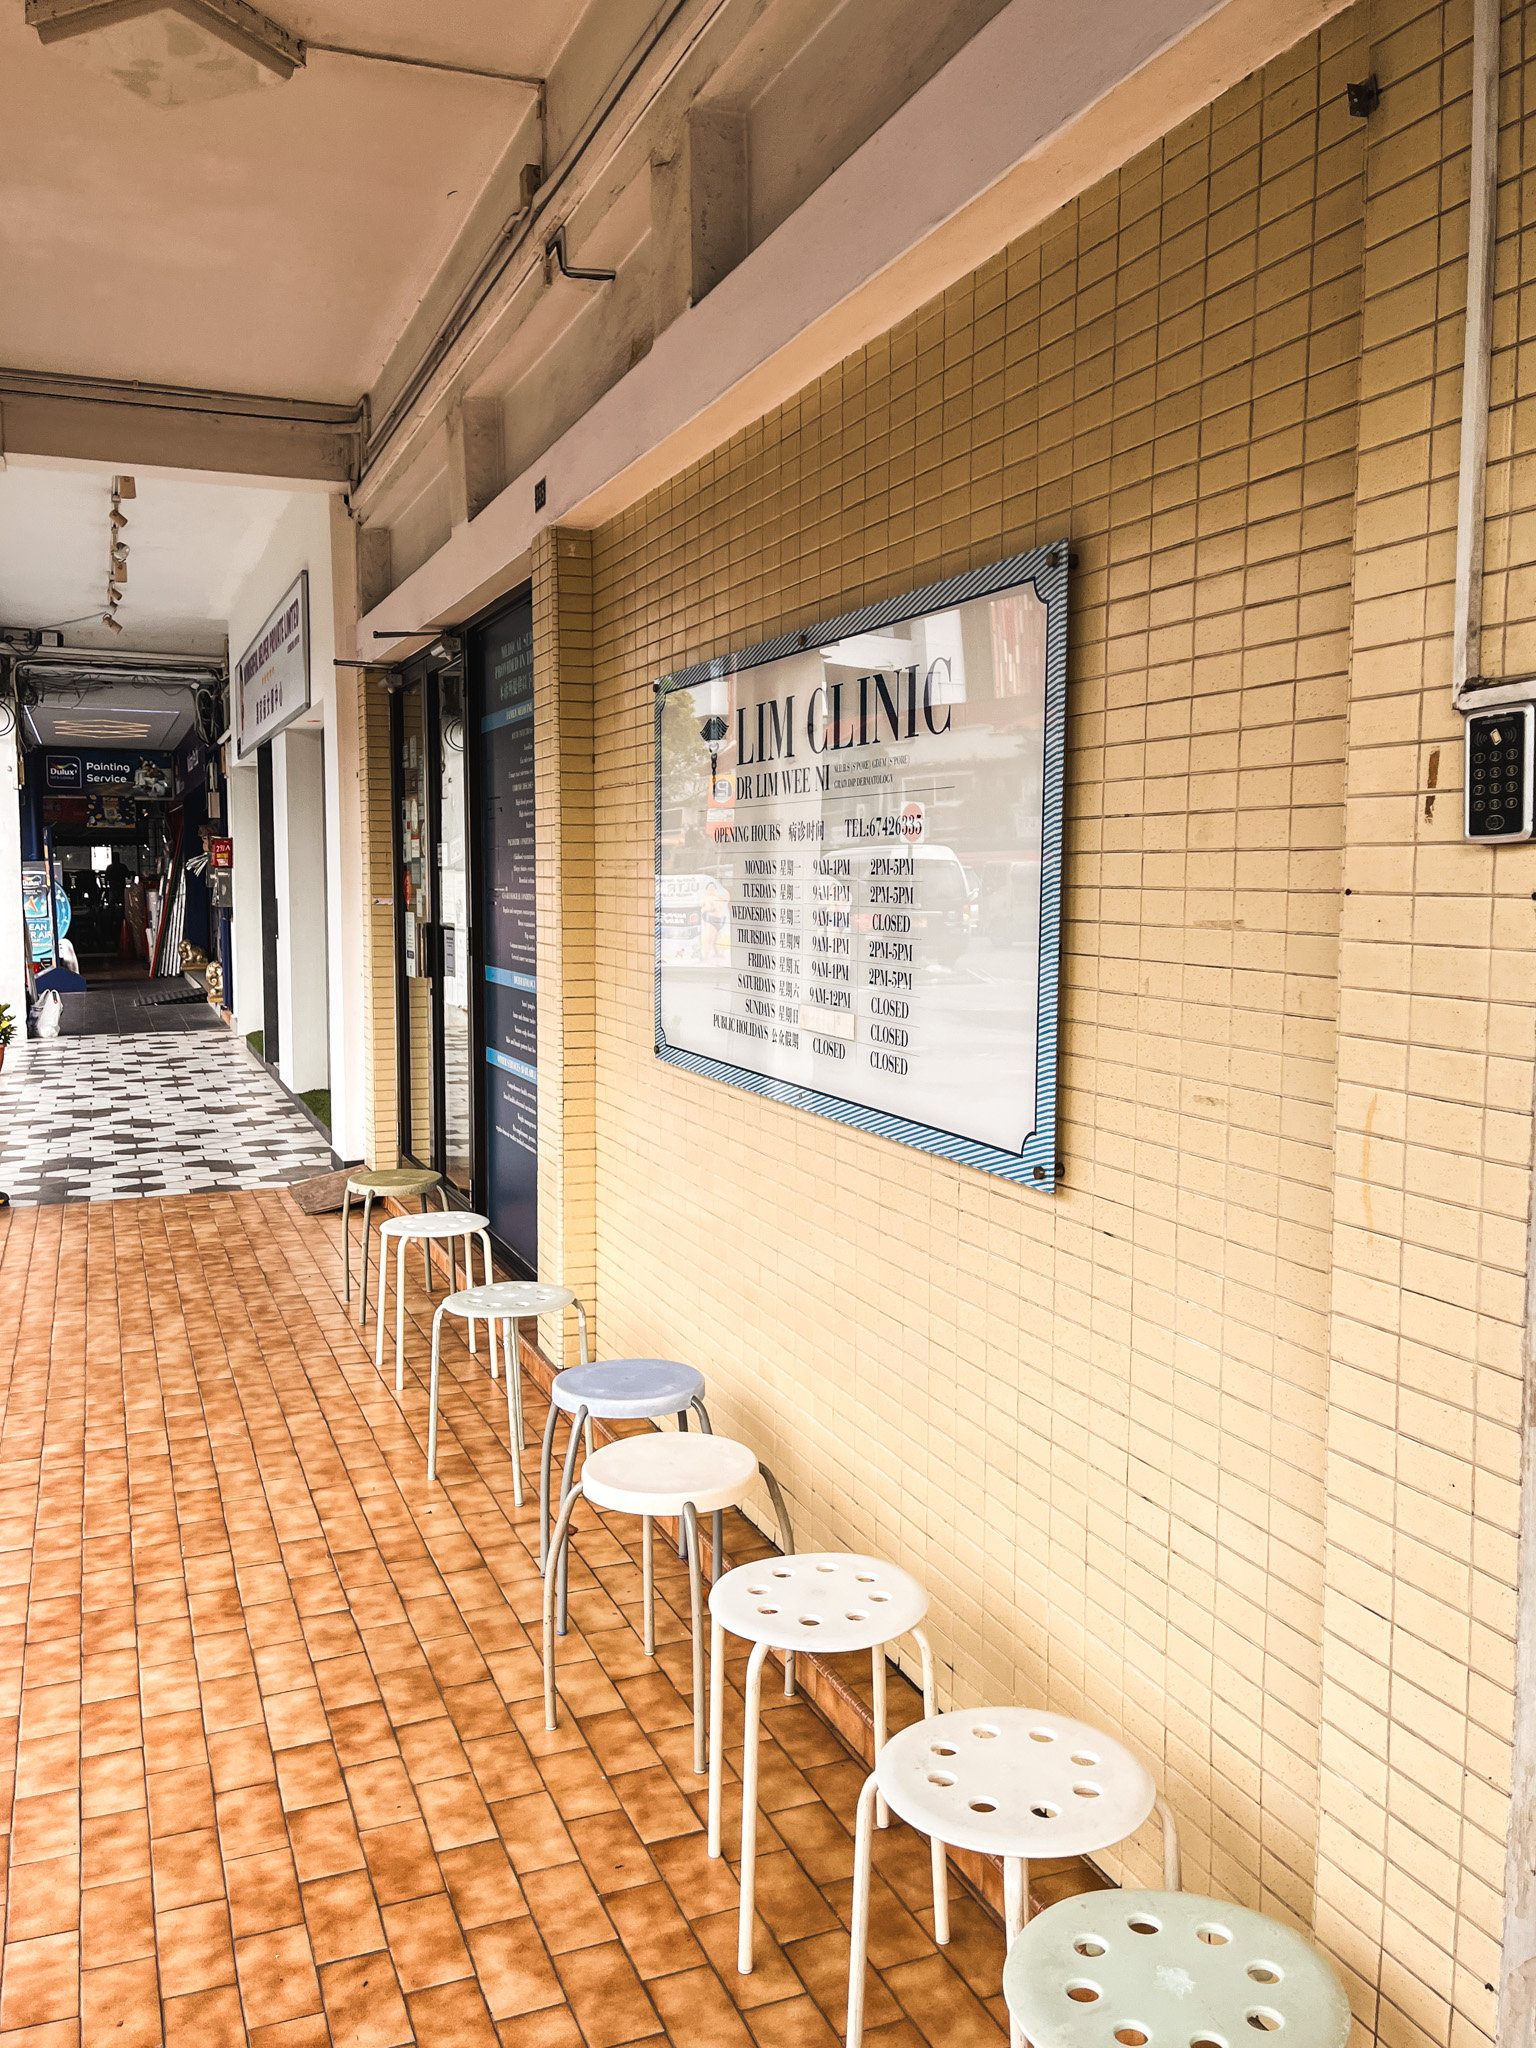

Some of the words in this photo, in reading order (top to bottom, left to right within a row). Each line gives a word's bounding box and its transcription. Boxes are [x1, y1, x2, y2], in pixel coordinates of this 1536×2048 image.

[736, 695, 795, 766] LIM
[807, 656, 951, 754] CLINIC
[50, 768, 75, 776] Dulux
[86, 762, 130, 773] Painting
[86, 774, 127, 783] Service
[736, 776, 752, 801] DR
[756, 770, 778, 798] LIM
[782, 767, 810, 794] WEE
[815, 764, 830, 791] NI
[714, 826, 749, 844] OPENING
[751, 823, 781, 842] HOURS
[744, 860, 777, 875] MONDAYS
[813, 859, 850, 875] 9AM-1PM
[870, 858, 914, 876] 2PM-5PM
[742, 883, 777, 898] TUESDAYS
[812, 885, 850, 901] 9AM-1PM
[870, 886, 914, 904] 2PM-5PM
[29, 923, 47, 931] EAN
[731, 905, 777, 922] WEDNESDAYS
[812, 910, 850, 928] 9AM-1PM
[872, 914, 910, 932] CLOSED
[737, 928, 776, 946] THURSDAYS
[812, 936, 849, 955] 9AM-1PM
[869, 941, 913, 961] 2PM-5PM
[748, 952, 776, 970] FRIDAYS
[812, 960, 849, 981] 9AM-1PM
[869, 968, 912, 990] 2PM-5PM
[738, 973, 776, 993] SATURDAYS
[809, 987, 851, 1008] 9AM-12PM
[871, 997, 909, 1019] CLOSED
[745, 999, 776, 1018] SUNDAYS
[870, 1024, 909, 1047] CLOSED
[713, 1013, 736, 1033] PUBLIC
[736, 1018, 769, 1041] HOLIDAYS
[812, 1037, 846, 1060] CLOSED
[870, 1050, 908, 1076] CLOSED
